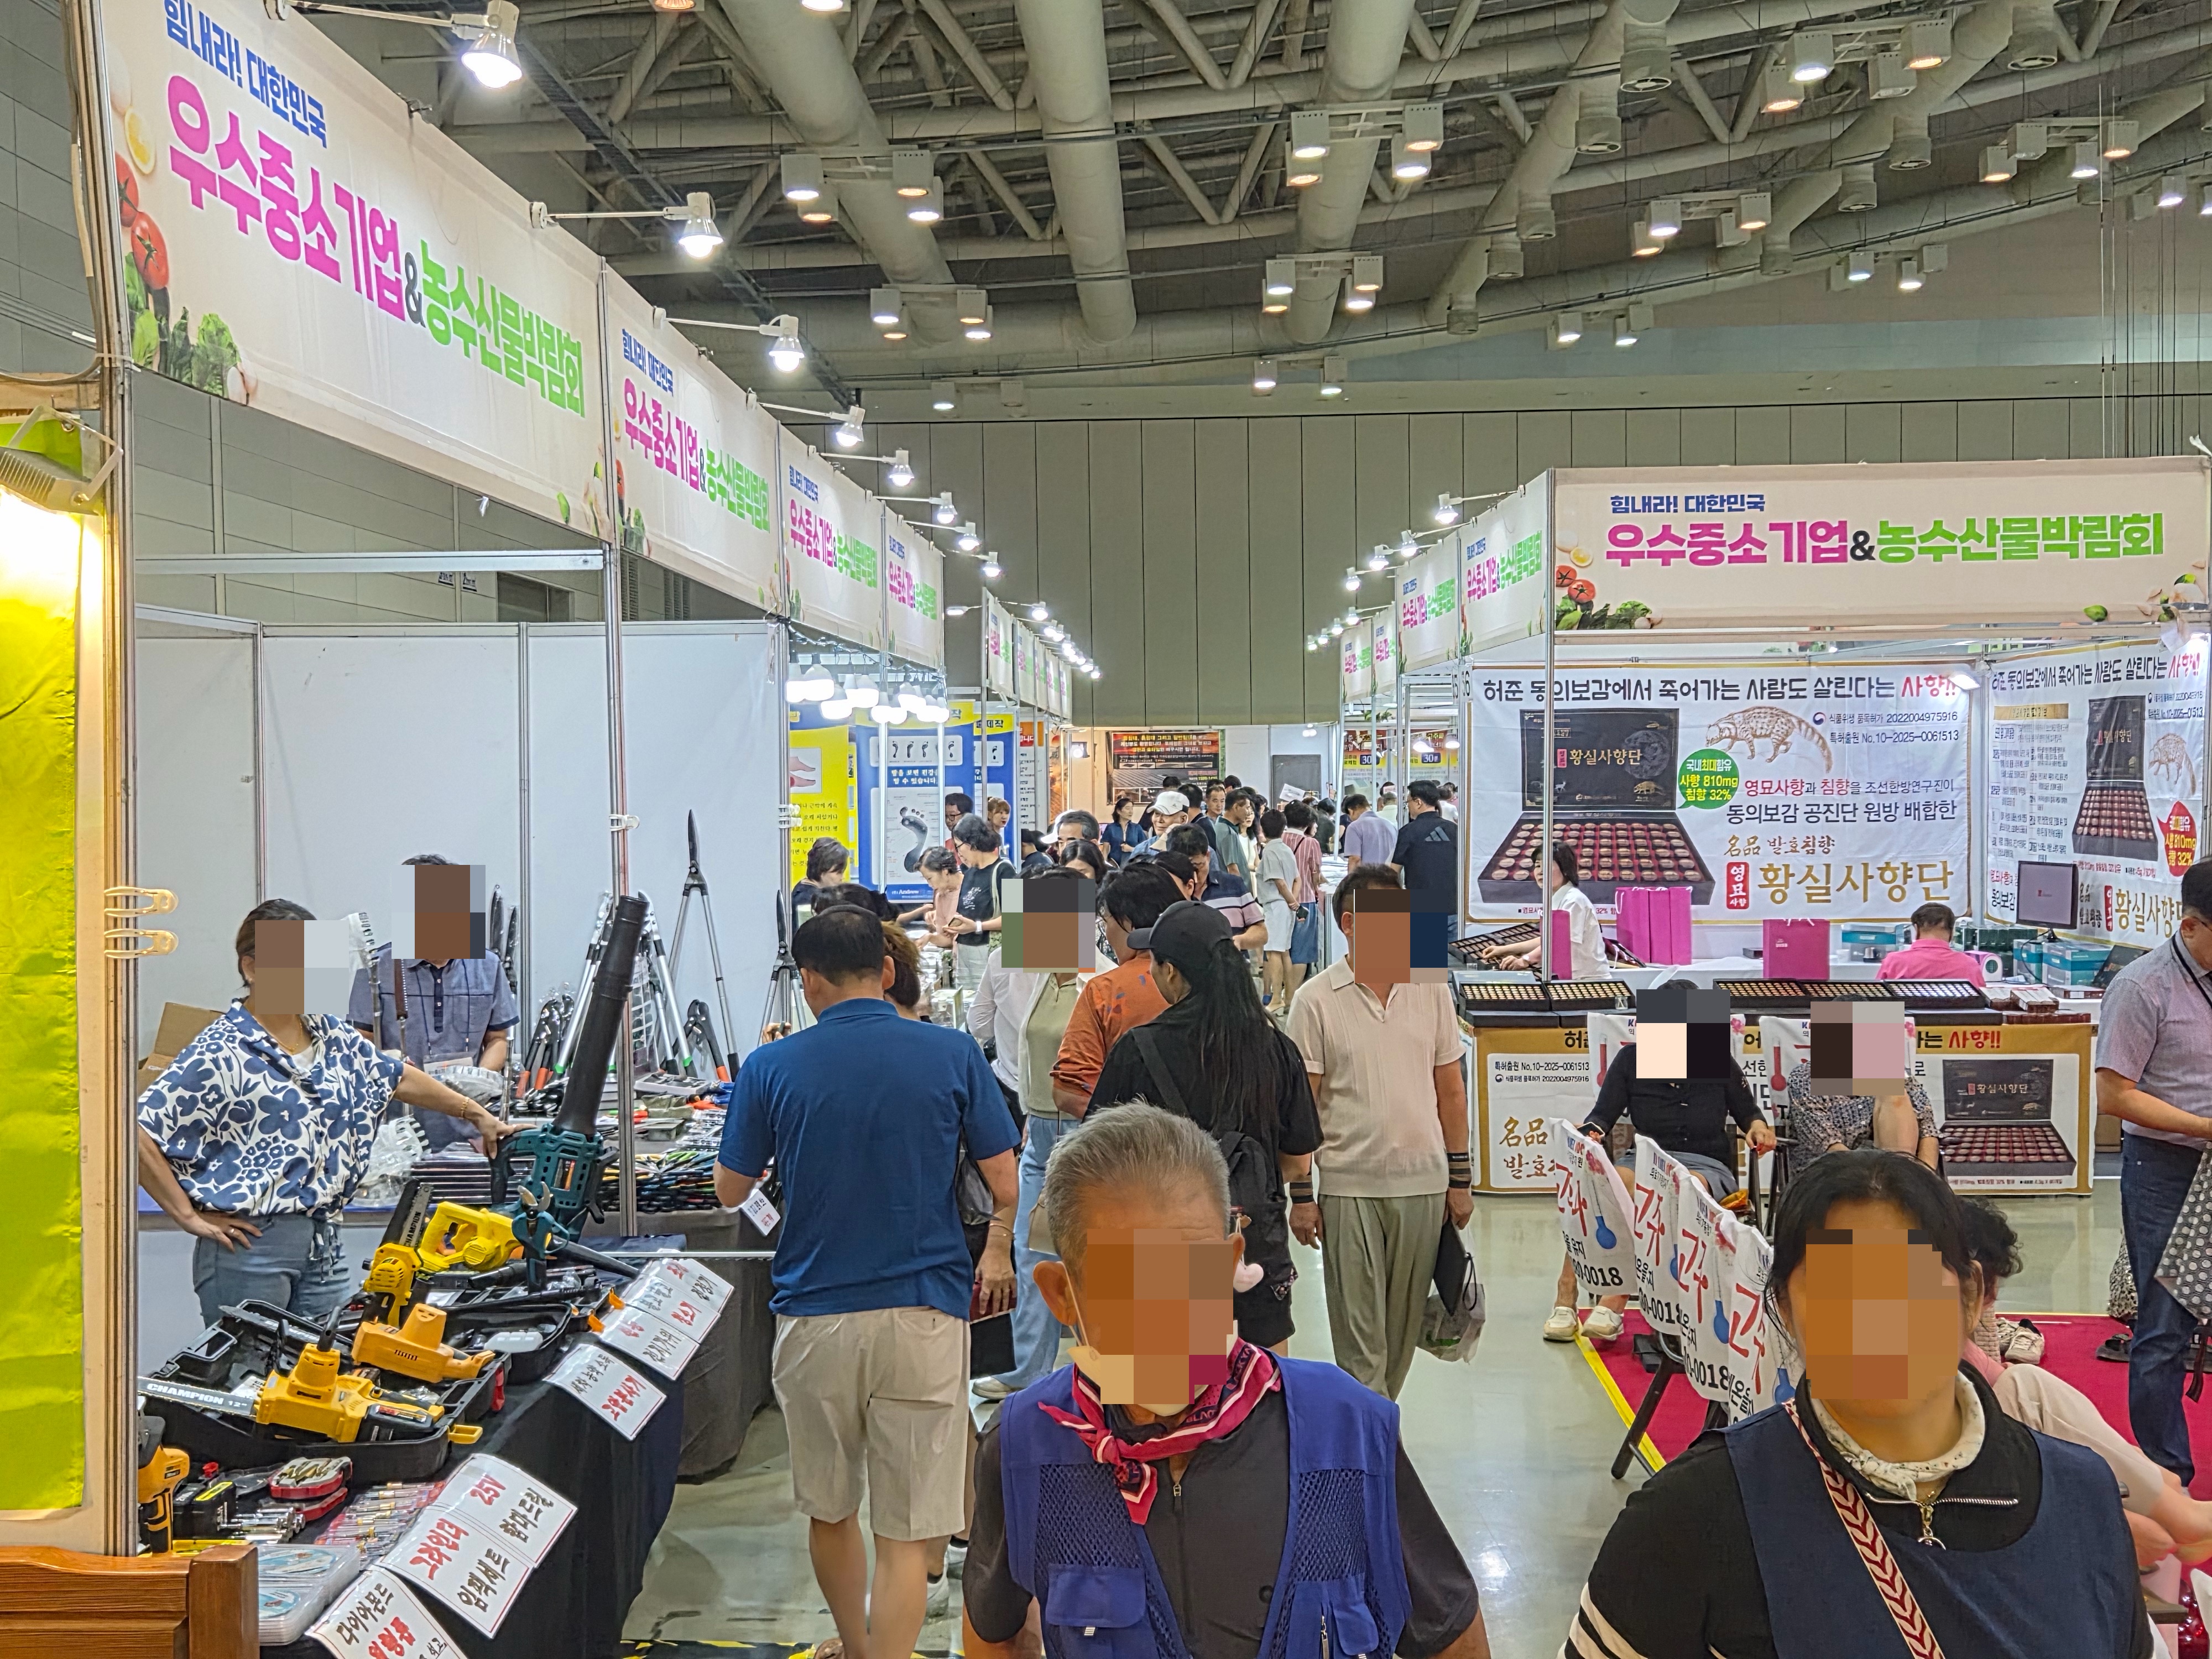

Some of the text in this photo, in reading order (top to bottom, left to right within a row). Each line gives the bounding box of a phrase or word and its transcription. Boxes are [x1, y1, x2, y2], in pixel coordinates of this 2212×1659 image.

[164, 0, 327, 148] 힘내라! 대한민국
[1610, 494, 1765, 514] 힘내라! 대한민국
[1606, 512, 2163, 567] 우수중소기업&농수산물박람회
[2059, 664, 2091, 686] 죽어가는
[2095, 659, 2122, 684] 사람도
[2126, 657, 2167, 680] 살린다는
[1484, 680, 1524, 702] 허준
[1531, 679, 1651, 702] 동의보감에서
[1660, 679, 1740, 701] 죽어가는
[1747, 678, 1807, 700] 사람도
[1814, 676, 1895, 698] 살린다는
[1886, 711, 1958, 723] 2022004975916
[1829, 731, 1859, 744] 특허출원
[1569, 749, 1642, 765] 황실사향단
[1686, 759, 1731, 773] 국내최대함유
[1679, 775, 1739, 789] 사향 810mg
[1744, 779, 1954, 797] 영묘사향과 침향을 조선한방연구진이
[1686, 788, 1732, 801] 침향 32%
[1726, 800, 1957, 825] 동의보감 공진단 원방 배합한
[1724, 834, 1761, 857] 名品
[1757, 860, 1954, 905] 황실사향단
[1949, 1031, 2000, 1049] 사향!!
[1499, 1117, 1548, 1147] 名品
[147, 1383, 224, 1405] CHAMPION
[469, 1474, 505, 1505] 25V
[410, 1518, 469, 1580] 그라인더
[337, 1583, 394, 1645] 다이아몬드
